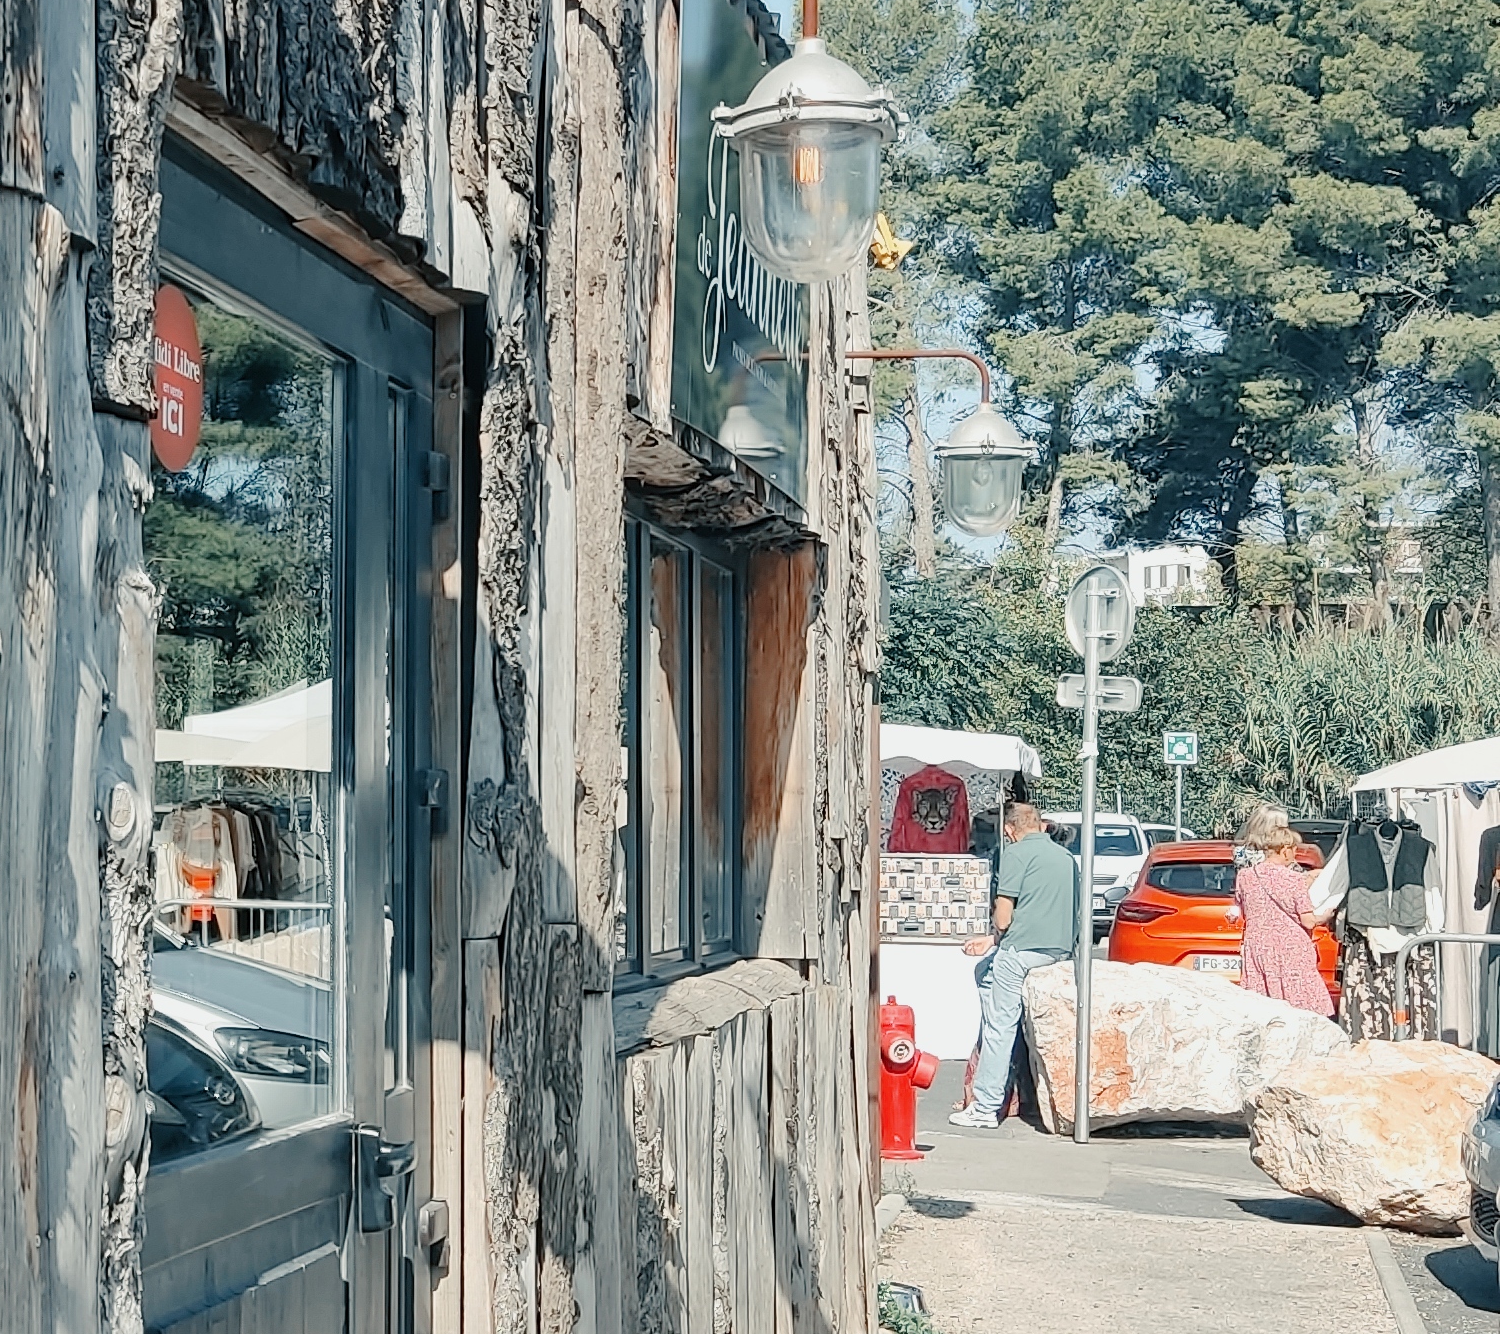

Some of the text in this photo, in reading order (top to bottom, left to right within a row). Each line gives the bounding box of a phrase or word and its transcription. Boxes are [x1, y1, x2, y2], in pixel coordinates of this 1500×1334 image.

[697, 215, 712, 279] de
[174, 346, 201, 384] Libre
[162, 395, 184, 437] ICI
